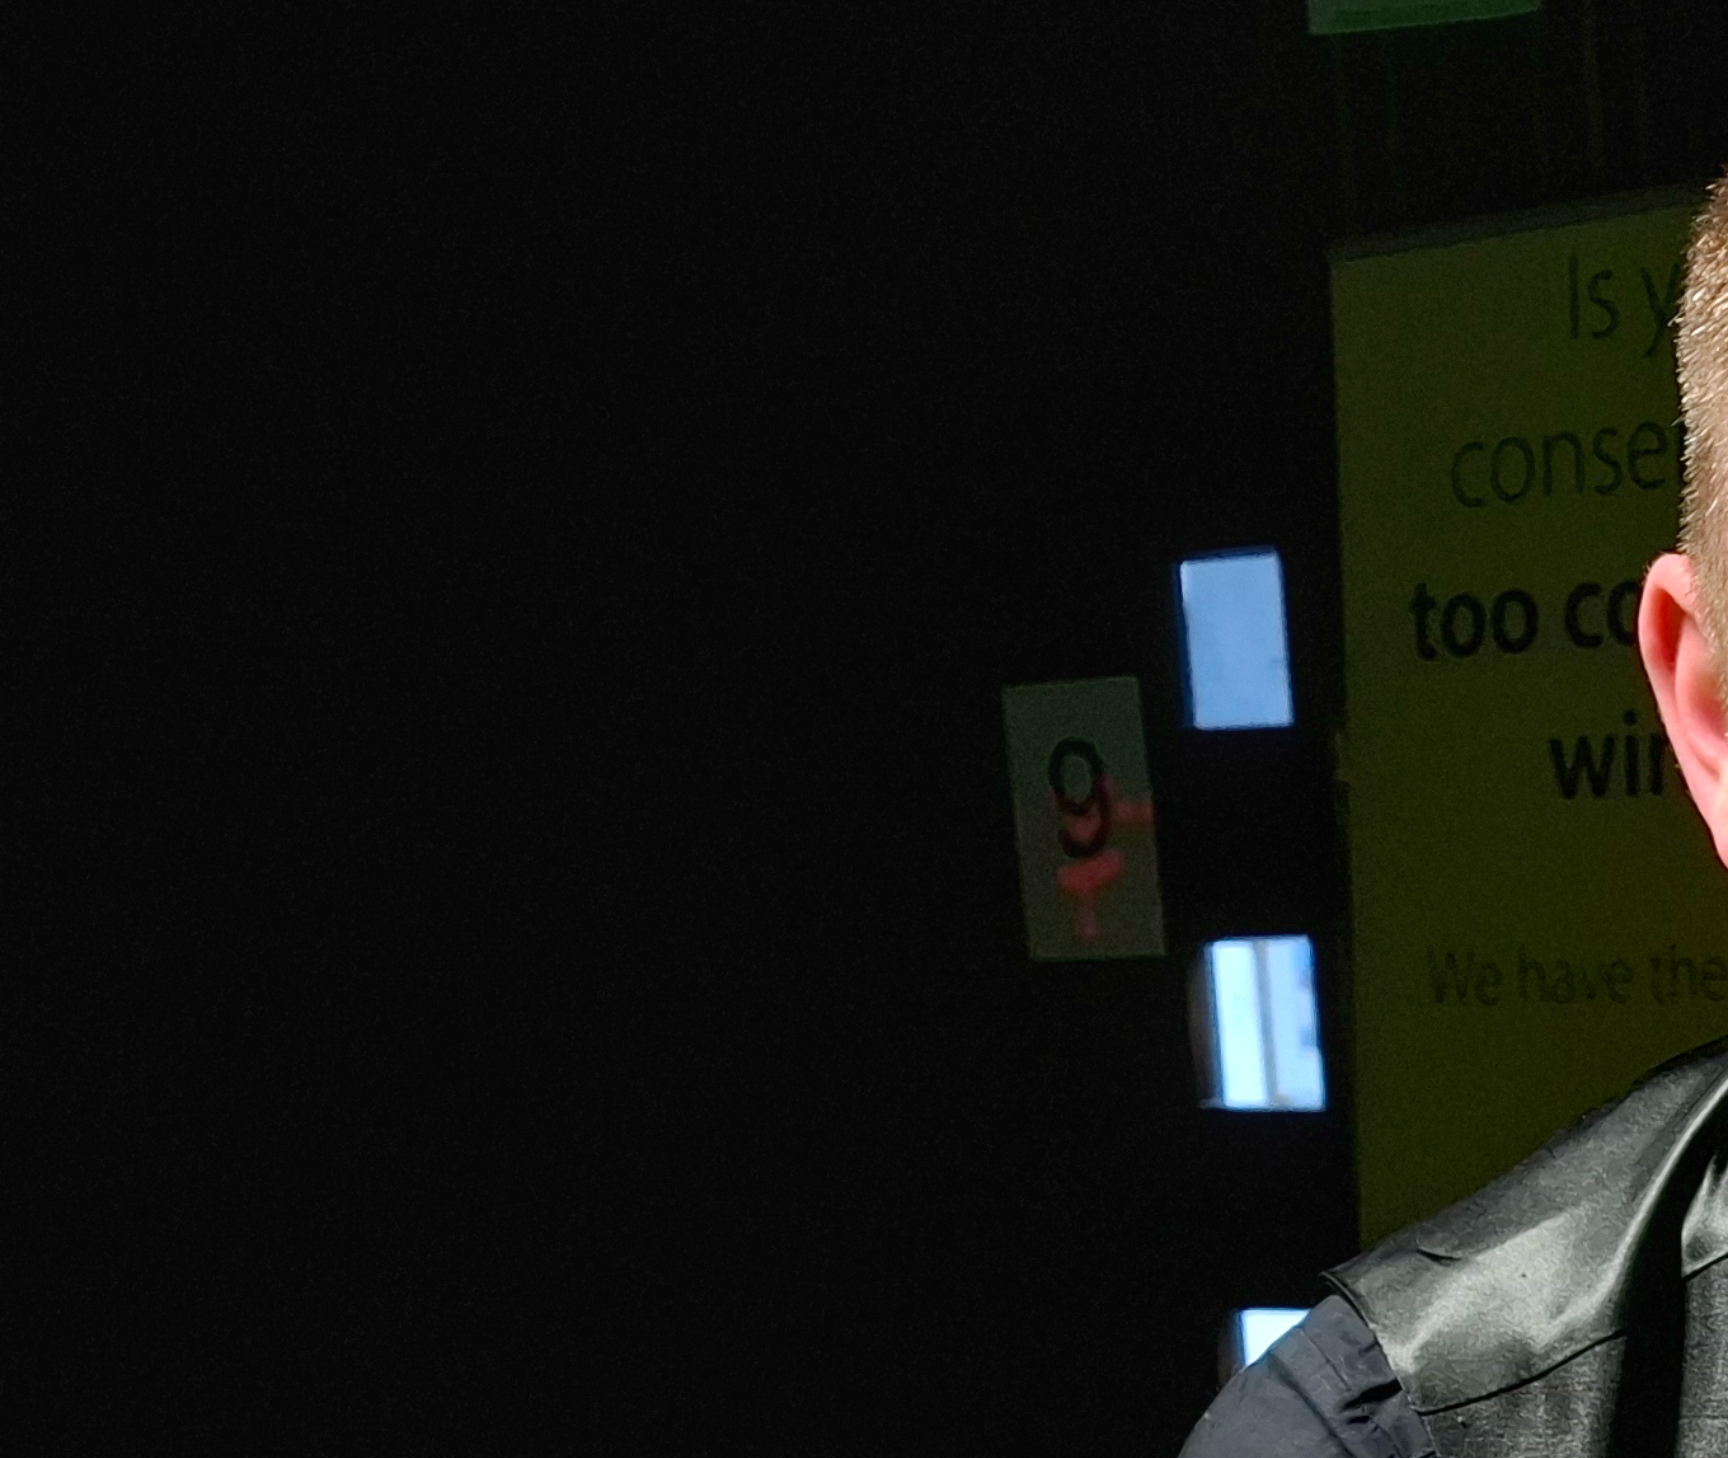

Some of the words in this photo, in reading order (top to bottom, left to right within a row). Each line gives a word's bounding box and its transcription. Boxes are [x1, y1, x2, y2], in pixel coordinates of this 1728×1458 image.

[1568, 248, 1620, 340] Is
[1451, 421, 1685, 508] conse
[1409, 582, 1538, 660] too
[1049, 737, 1111, 858] 9
